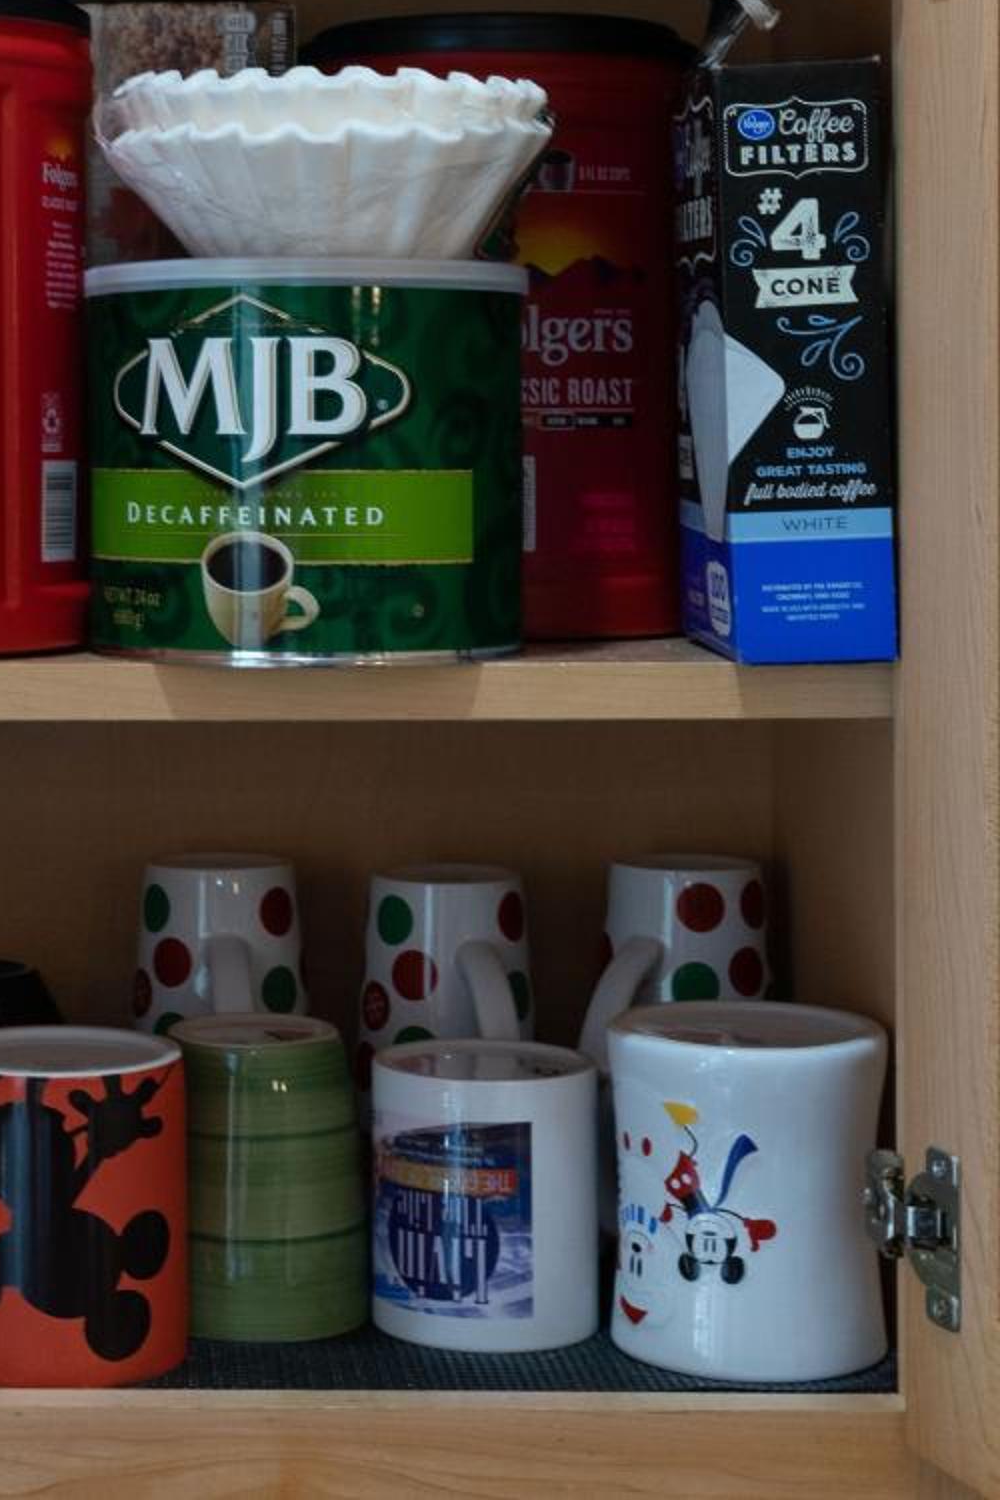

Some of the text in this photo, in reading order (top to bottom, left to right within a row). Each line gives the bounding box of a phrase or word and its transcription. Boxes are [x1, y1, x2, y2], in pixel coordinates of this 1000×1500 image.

[778, 108, 855, 143] Coffee
[739, 142, 857, 166] FILTERS
[771, 277, 842, 297] CONE
[521, 304, 633, 367] lgers
[138, 335, 368, 463] MJB
[567, 377, 634, 405] ROAST
[786, 446, 835, 459] ENJOY
[756, 462, 867, 478] GREAT TASTING
[743, 480, 877, 506] full bodied coffee
[782, 516, 849, 532] WHITE
